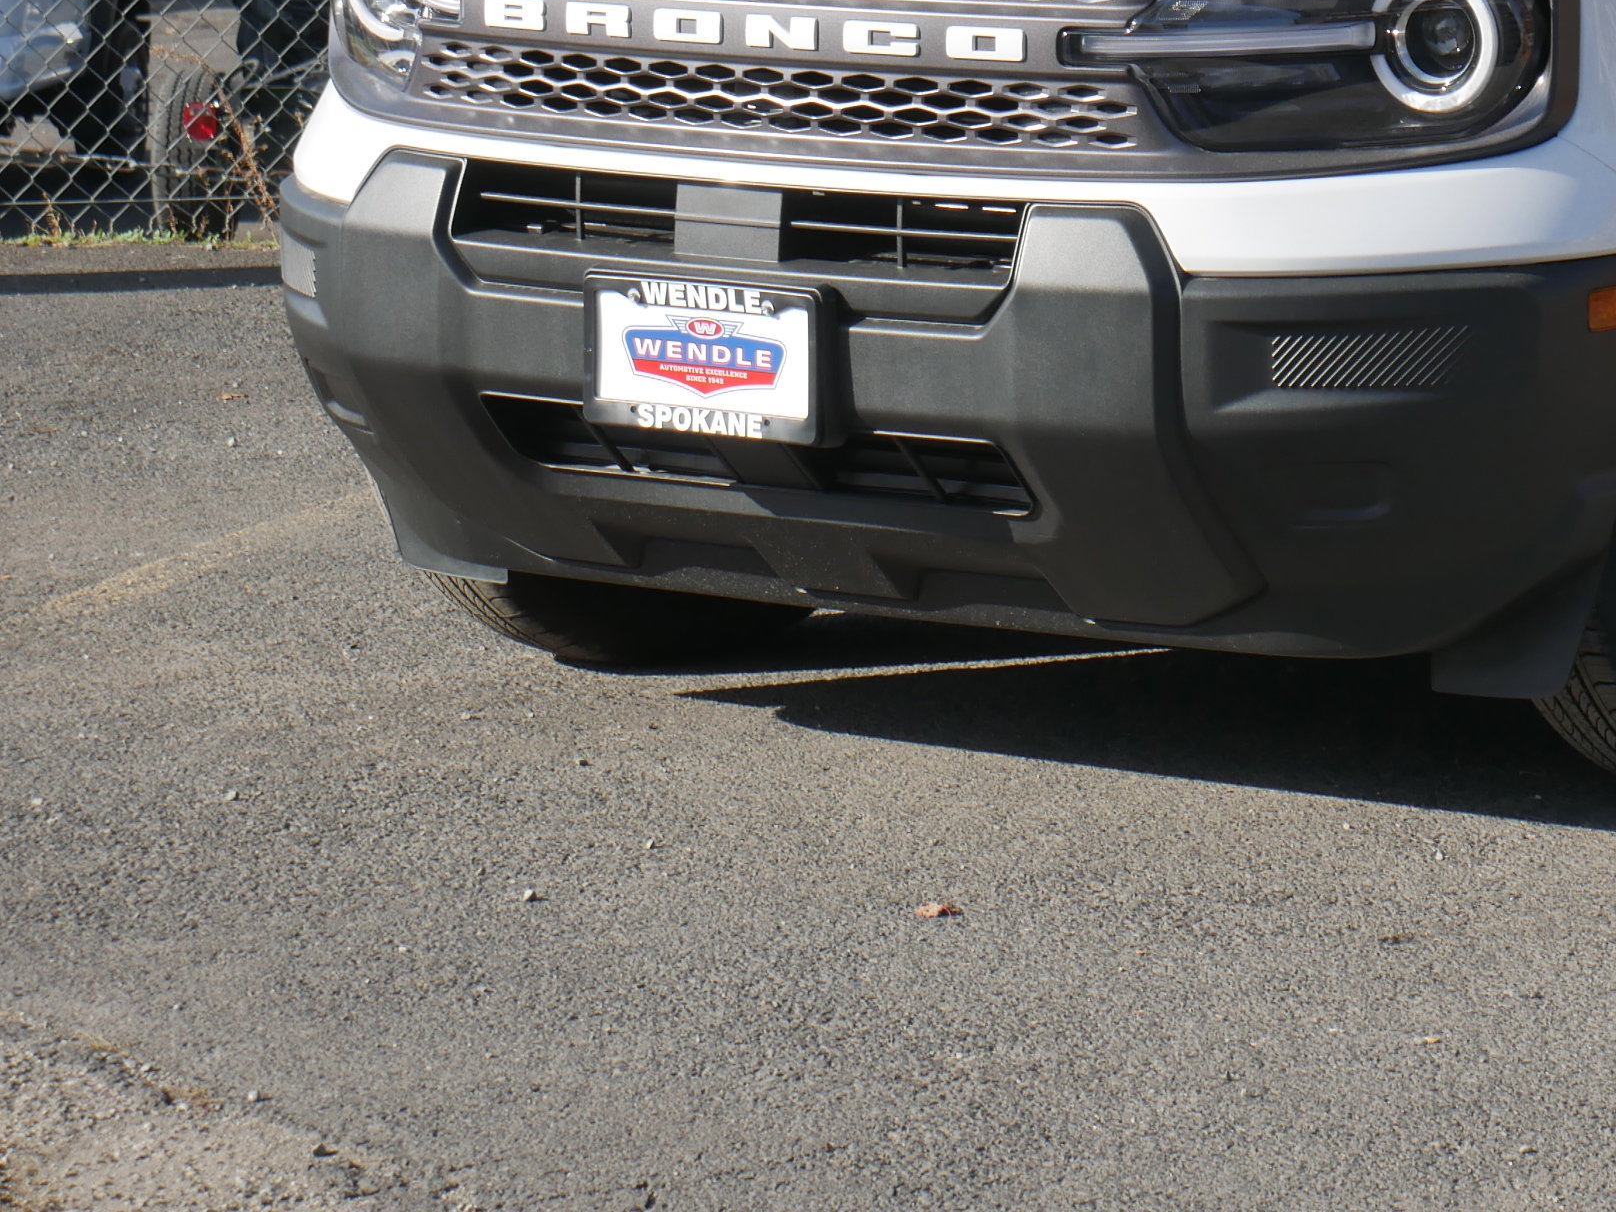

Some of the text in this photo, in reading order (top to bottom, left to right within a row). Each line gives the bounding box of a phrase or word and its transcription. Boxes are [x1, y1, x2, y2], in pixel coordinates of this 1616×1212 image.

[640, 281, 762, 314] WENDLE
[634, 337, 773, 368] WENDLE
[659, 364, 748, 379] AUTOMOTIVE EXCELLENCE
[685, 374, 707, 383] SINCE
[637, 403, 763, 439] SPOKANE
